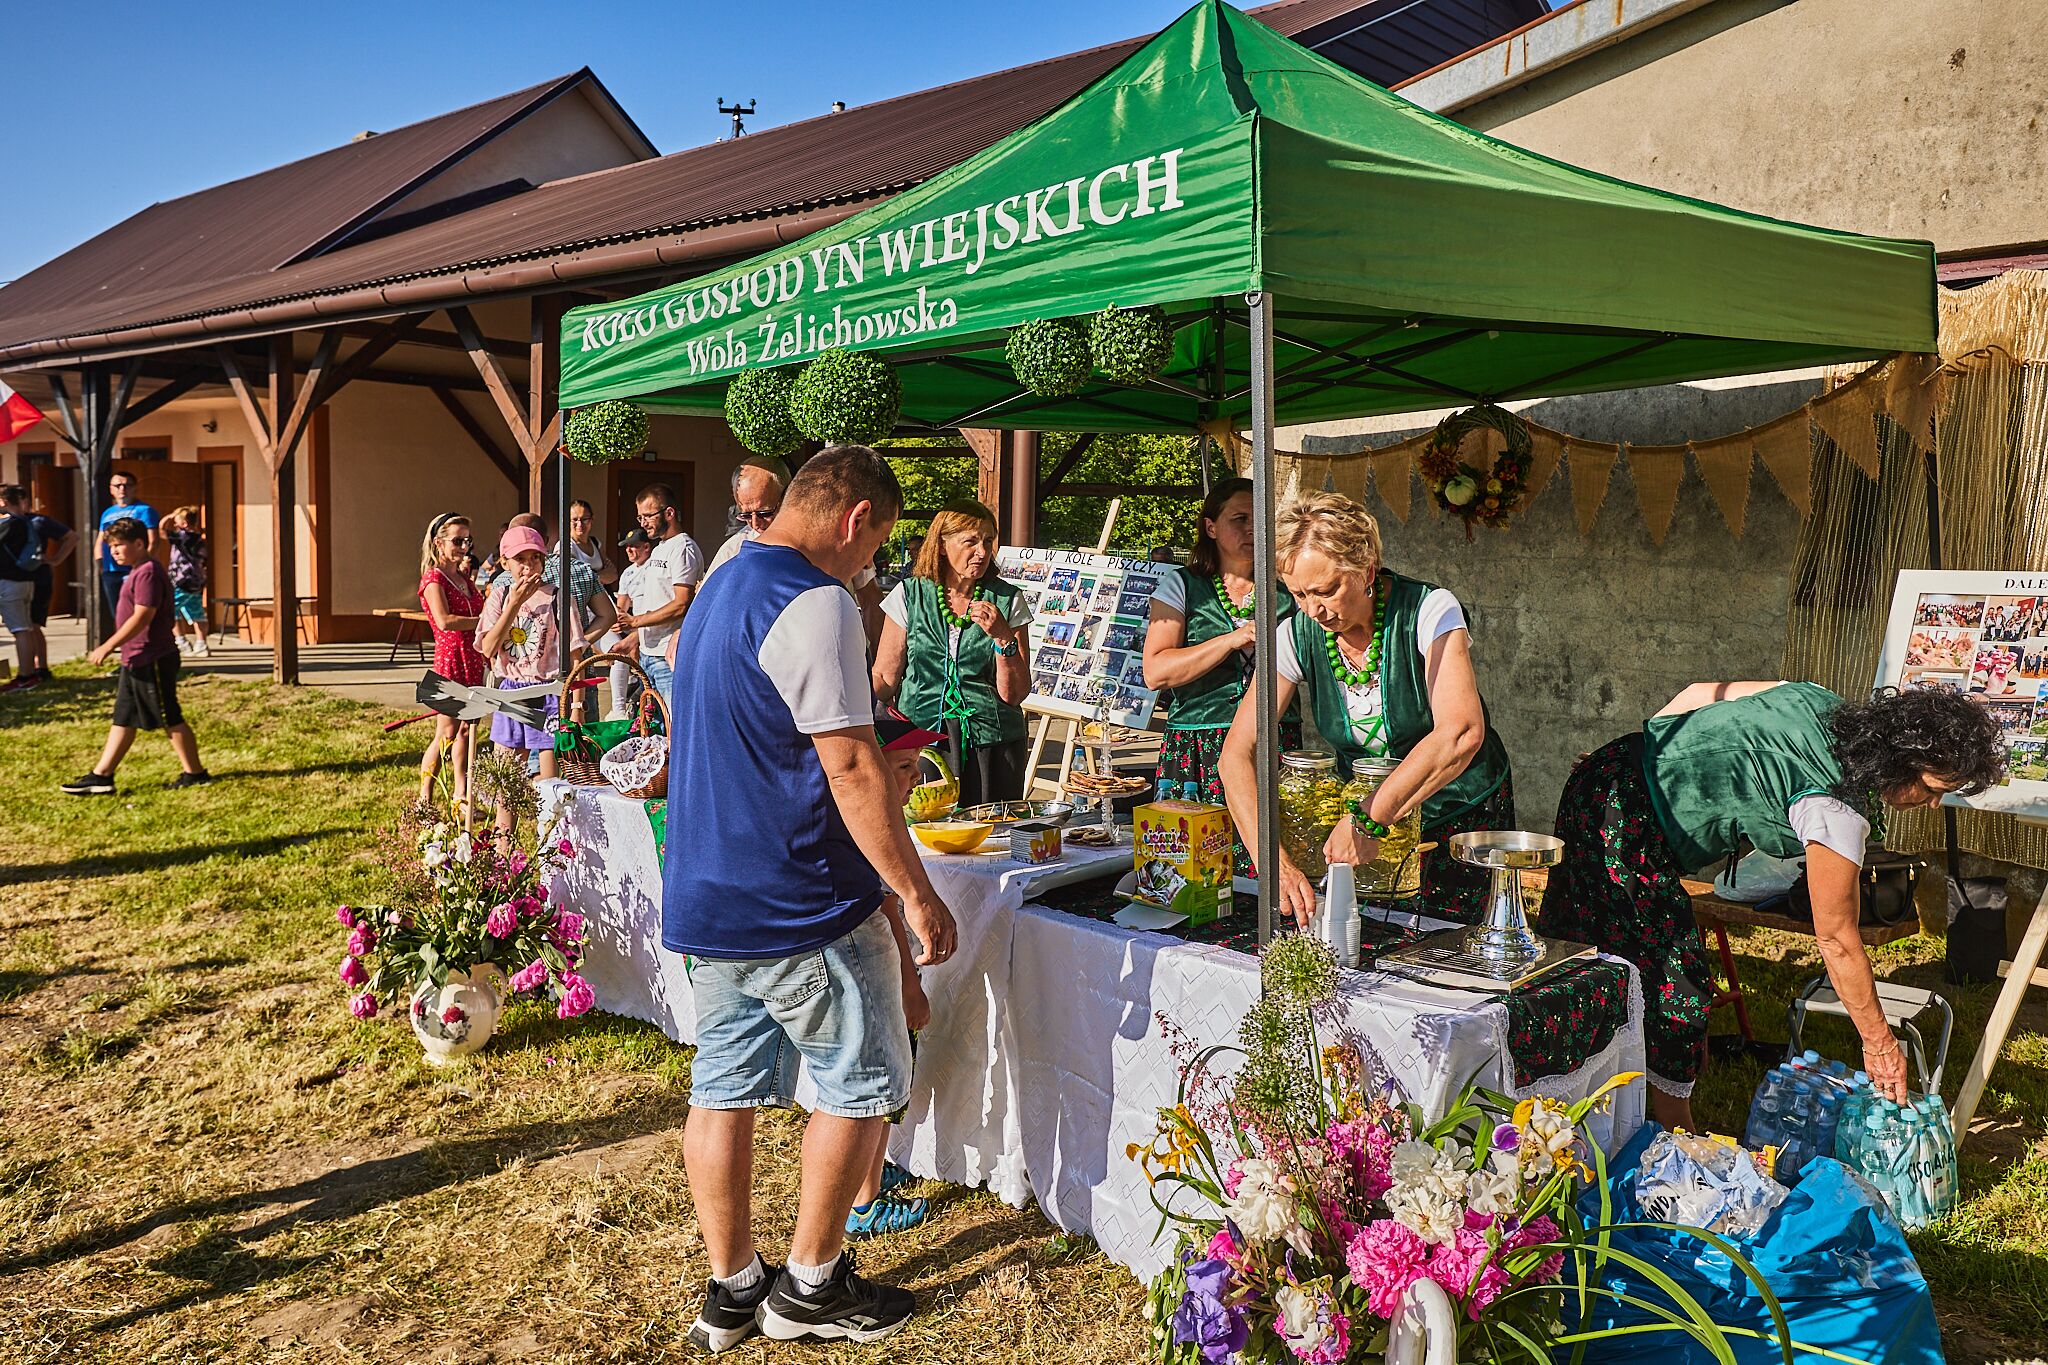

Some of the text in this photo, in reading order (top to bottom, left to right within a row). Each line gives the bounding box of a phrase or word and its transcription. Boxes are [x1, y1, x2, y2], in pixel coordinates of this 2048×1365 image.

[879, 147, 1185, 276] WIEJSKICH
[686, 286, 958, 376] Wola Żelichowska
[1019, 548, 1034, 560] CO
[1045, 550, 1057, 562] W
[1065, 552, 1094, 566] KOLE
